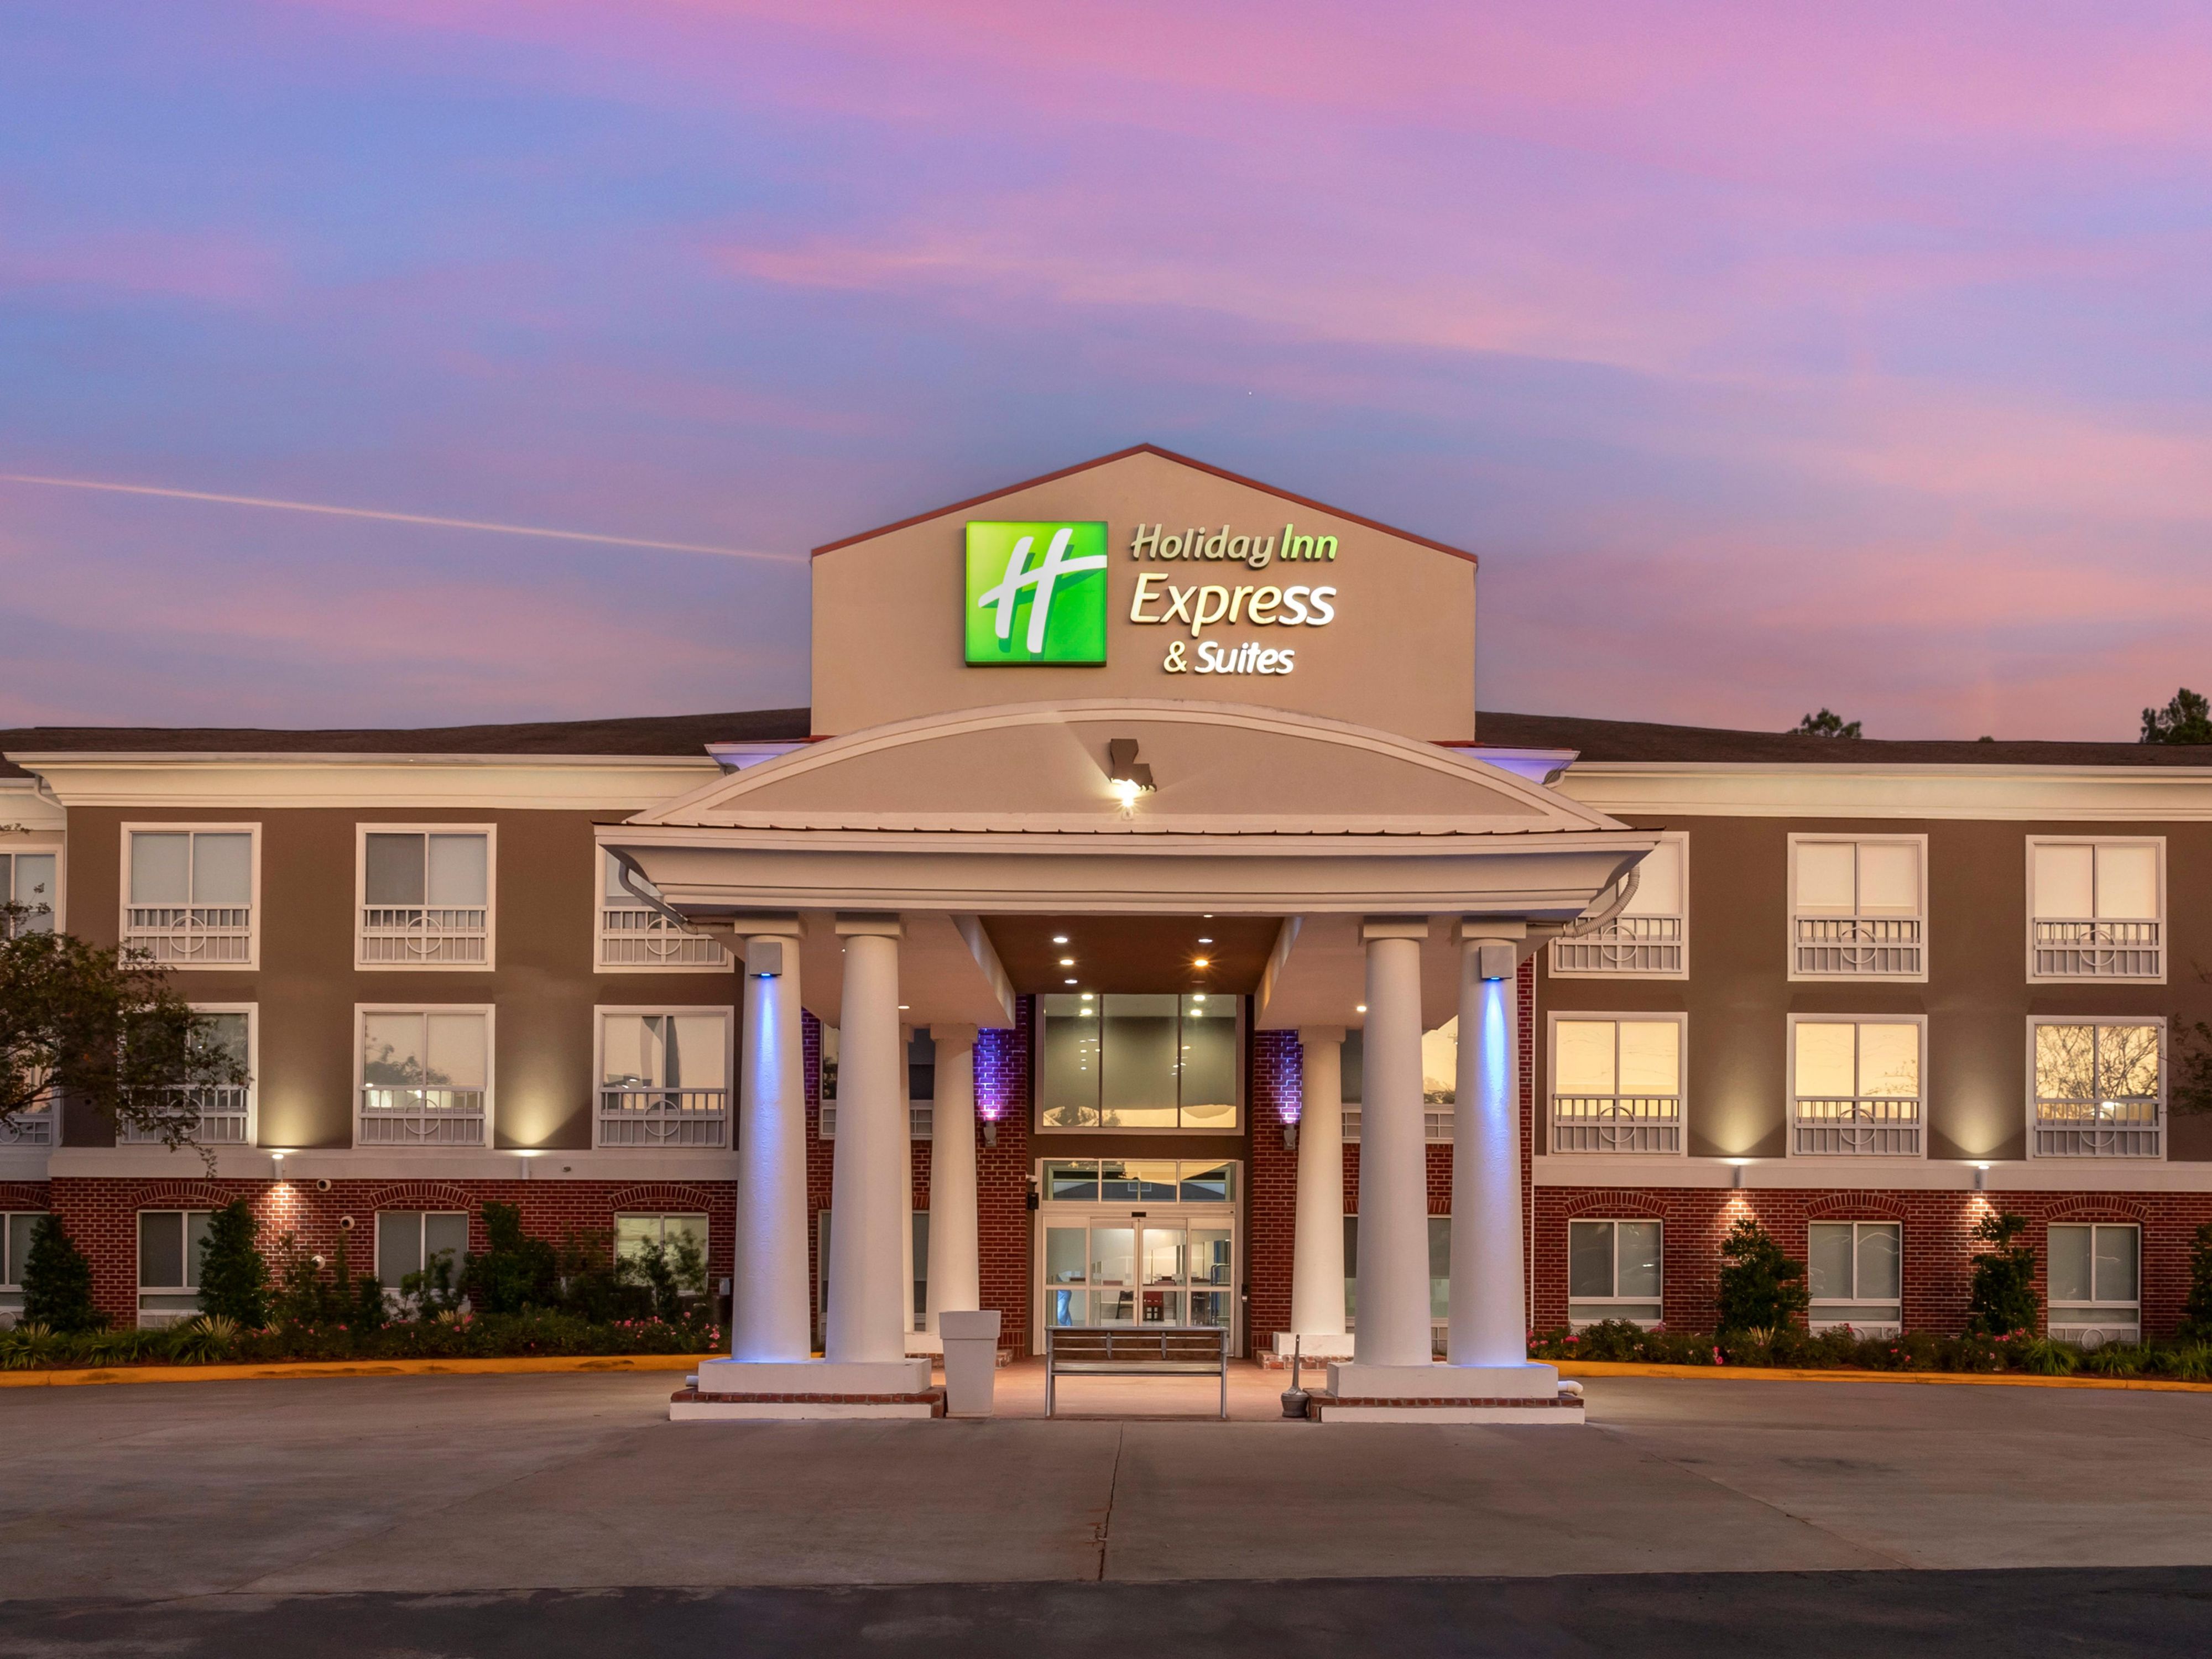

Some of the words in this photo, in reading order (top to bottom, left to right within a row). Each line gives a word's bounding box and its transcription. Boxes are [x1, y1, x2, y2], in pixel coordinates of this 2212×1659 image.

[1130, 523, 1275, 568] Holiday
[1280, 523, 1338, 560] Inn
[978, 528, 1108, 653] H
[1130, 573, 1337, 637] Express
[1164, 641, 1187, 673] &
[1194, 641, 1295, 674] Suites
